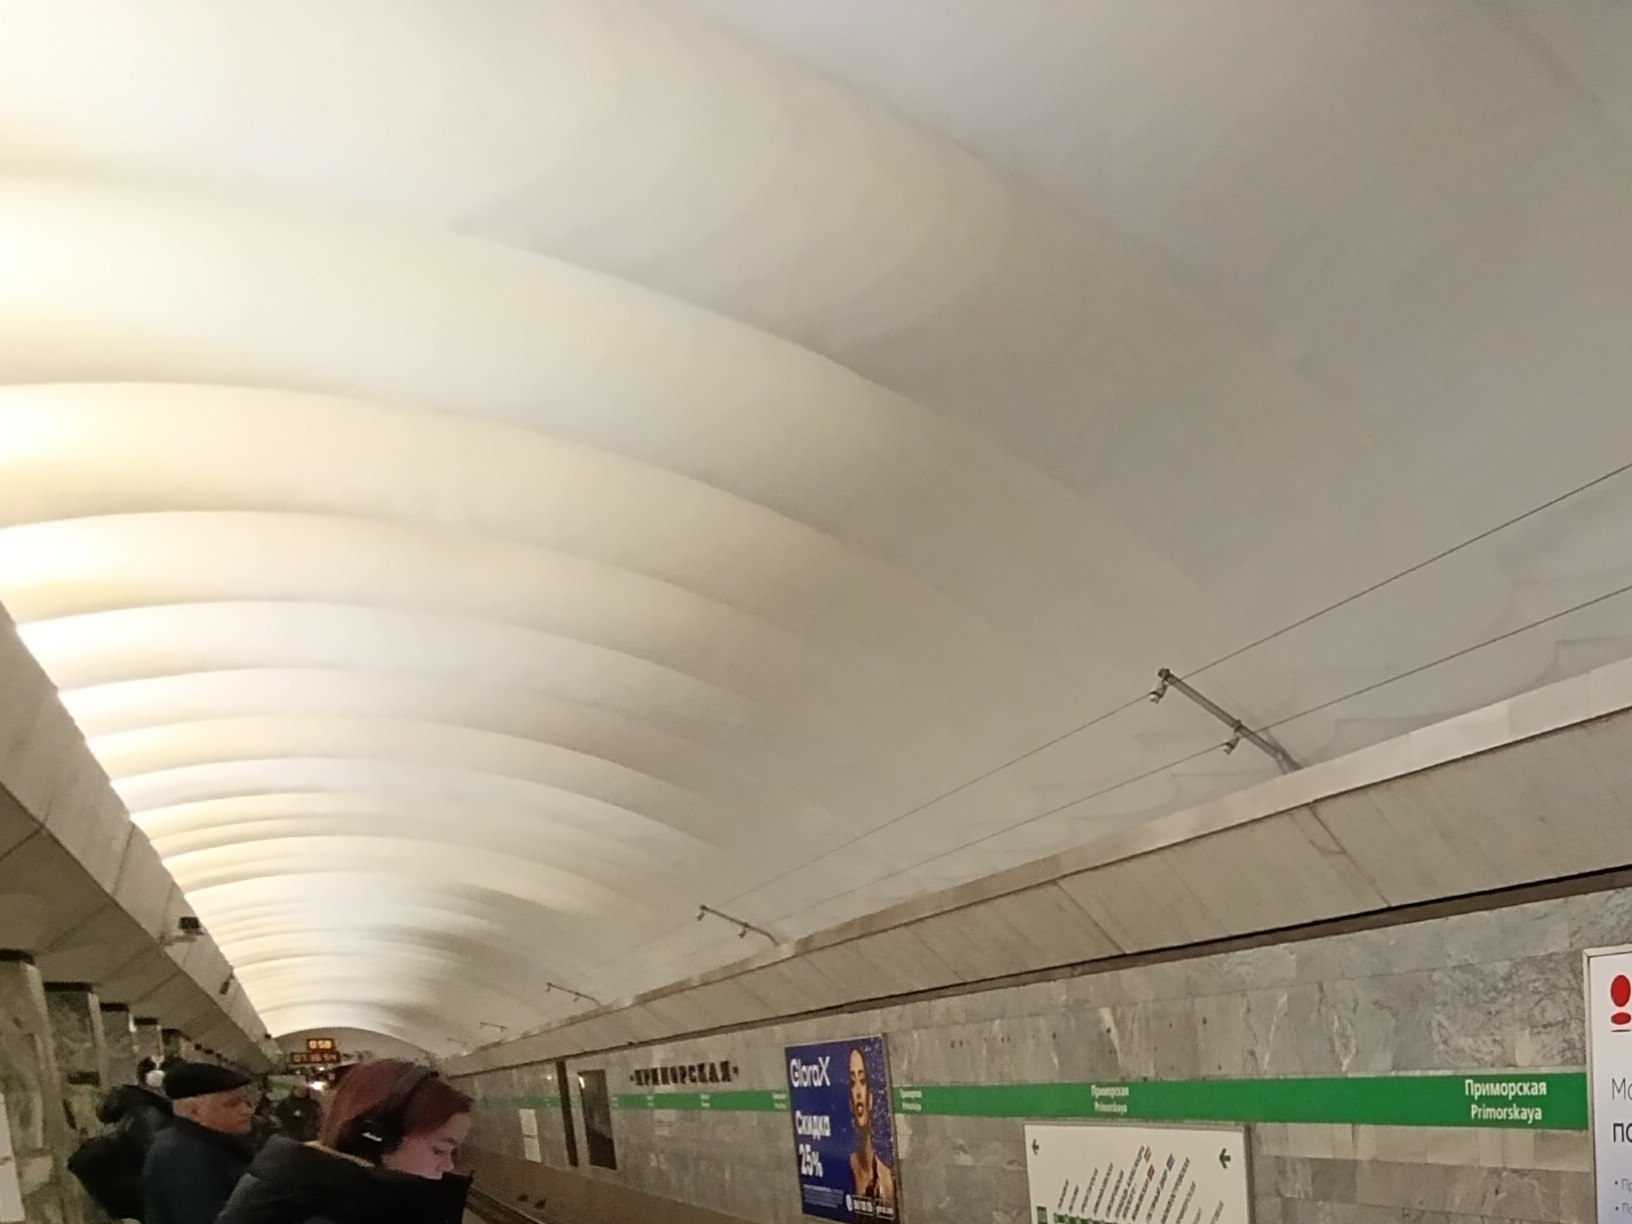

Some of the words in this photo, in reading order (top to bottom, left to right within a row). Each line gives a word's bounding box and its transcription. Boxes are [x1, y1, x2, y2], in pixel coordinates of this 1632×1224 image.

[790, 1055, 831, 1088] GloraX
[1465, 1079, 1547, 1100] Приморская
[795, 1110, 831, 1140] Скидка
[1471, 1103, 1542, 1124] Primorskaya
[799, 1144, 823, 1178] 25%
